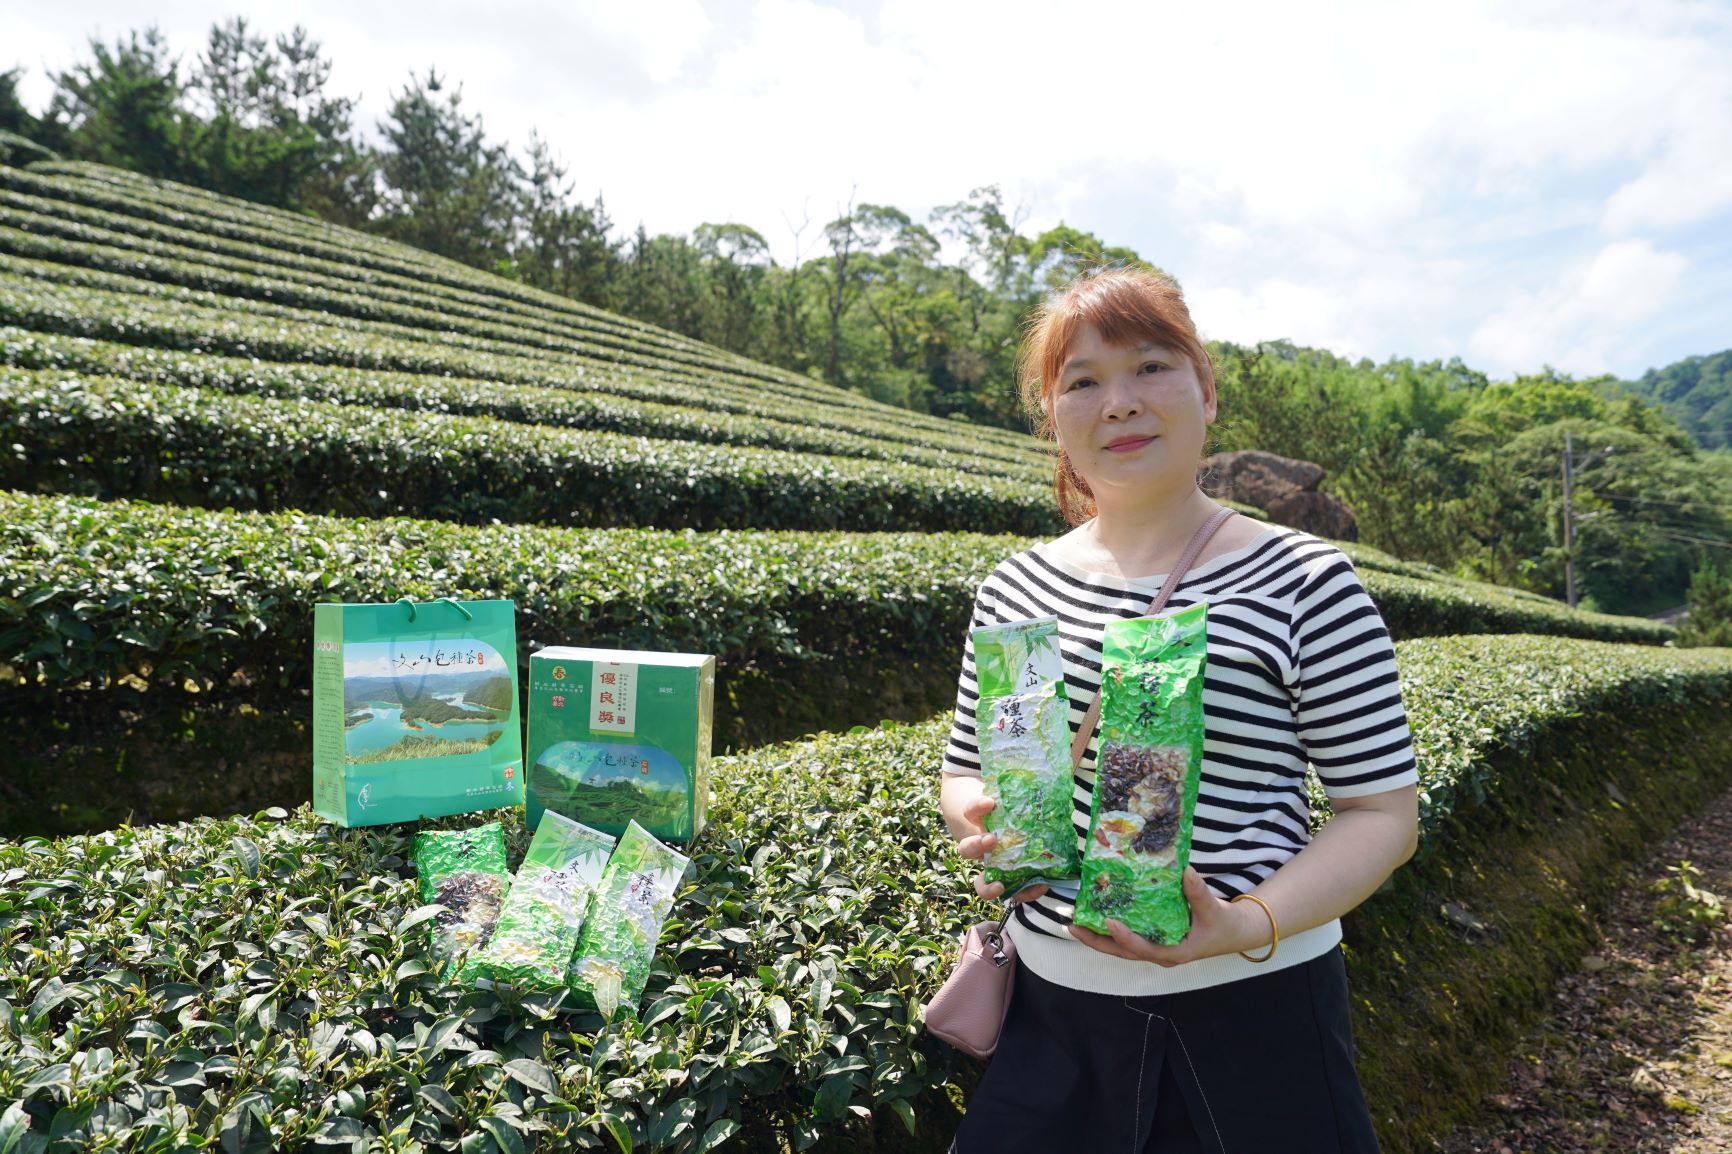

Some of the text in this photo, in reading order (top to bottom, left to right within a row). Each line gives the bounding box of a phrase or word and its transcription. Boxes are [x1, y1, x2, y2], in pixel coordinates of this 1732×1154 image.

[392, 649, 476, 670] 文山包種茶
[1025, 663, 1037, 688] 文山
[598, 672, 616, 724] 優良獎
